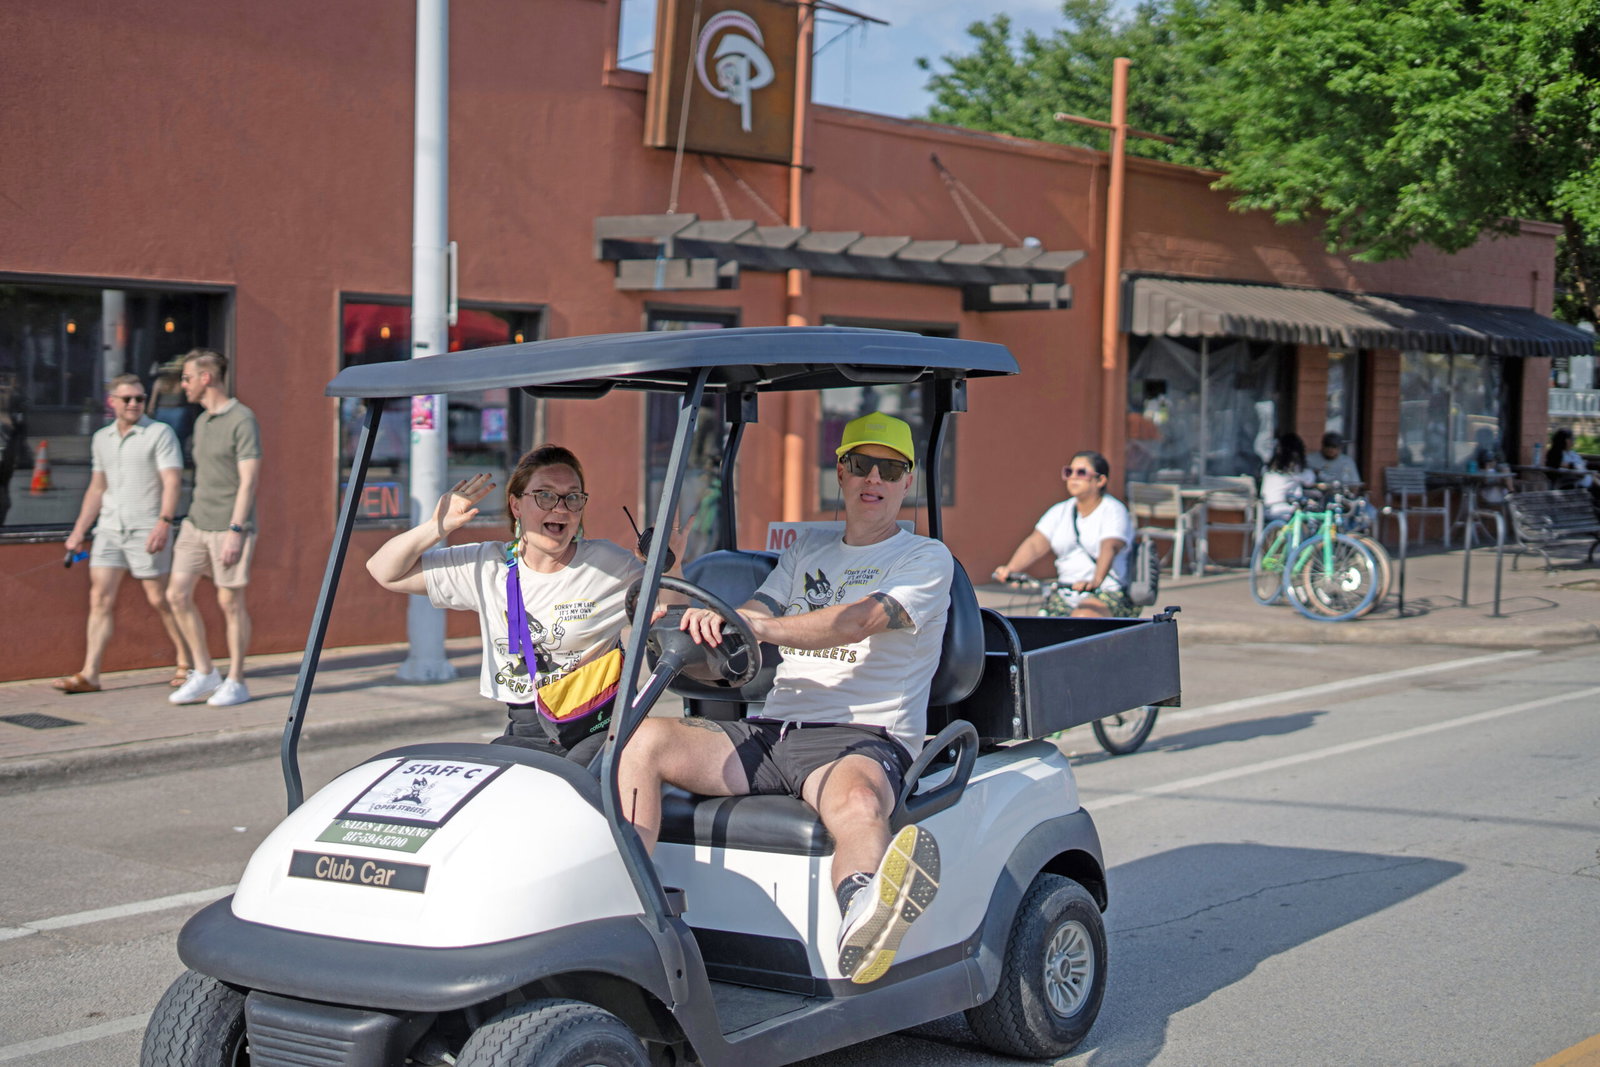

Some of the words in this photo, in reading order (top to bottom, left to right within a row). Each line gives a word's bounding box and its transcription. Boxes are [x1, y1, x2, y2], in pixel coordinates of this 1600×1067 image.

[769, 528, 797, 550] NO
[495, 672, 527, 693] OEN
[402, 763, 465, 777] STAFF
[463, 768, 483, 779] C
[396, 804, 427, 815] STREETS
[341, 819, 374, 831] SALES
[373, 822, 383, 832] &
[382, 823, 432, 838] LEASING
[342, 831, 409, 848] 817-594-8700
[315, 855, 355, 881] Club
[360, 861, 396, 886] Car
